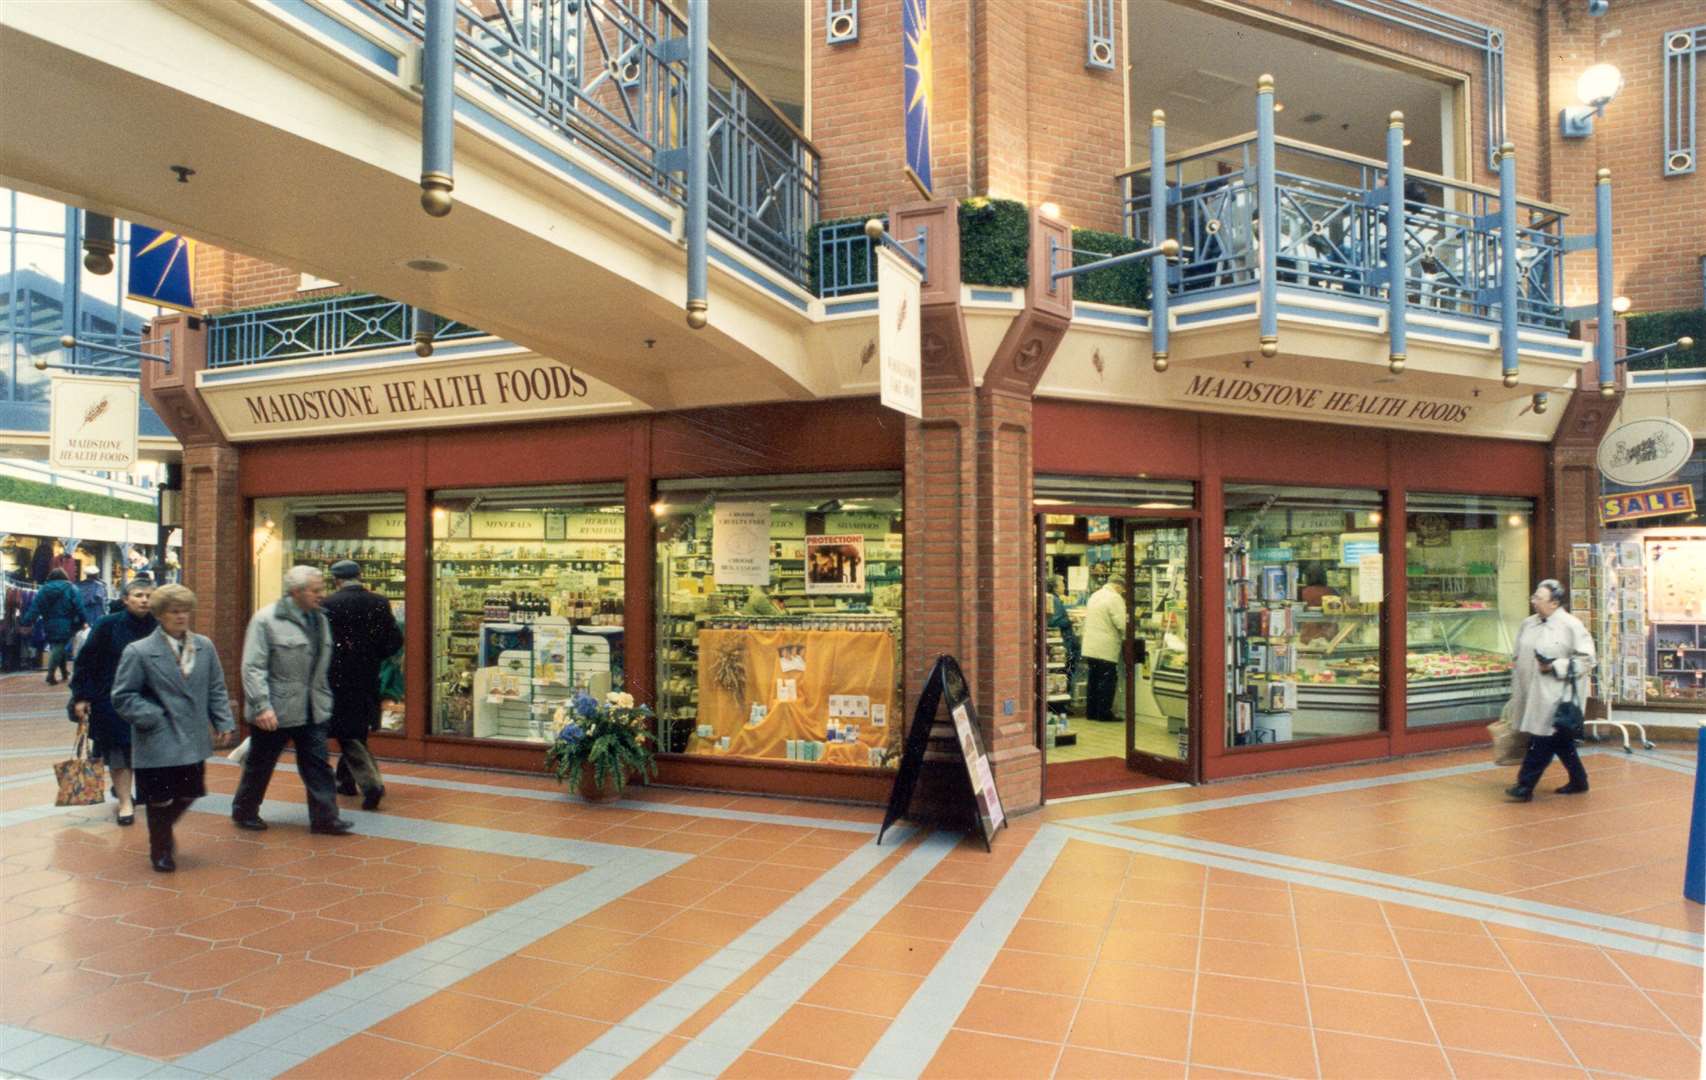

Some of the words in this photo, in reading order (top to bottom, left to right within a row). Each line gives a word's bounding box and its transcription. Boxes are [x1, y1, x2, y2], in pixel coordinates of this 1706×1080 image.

[245, 385, 379, 425] MAIDSTONE
[384, 374, 487, 413] HEALTH
[496, 366, 588, 404] FOODS
[1184, 375, 1323, 409] MAIDSTONE
[1323, 391, 1409, 417] HEALTH
[1407, 400, 1473, 423] FOODS
[68, 439, 121, 449] MAIDSTONE
[60, 450, 98, 461] HEALTH
[99, 451, 129, 462] FOODS
[1604, 492, 1686, 516] SALE
[486, 520, 532, 530] MINERALS
[807, 535, 862, 545] PROTECTION!
